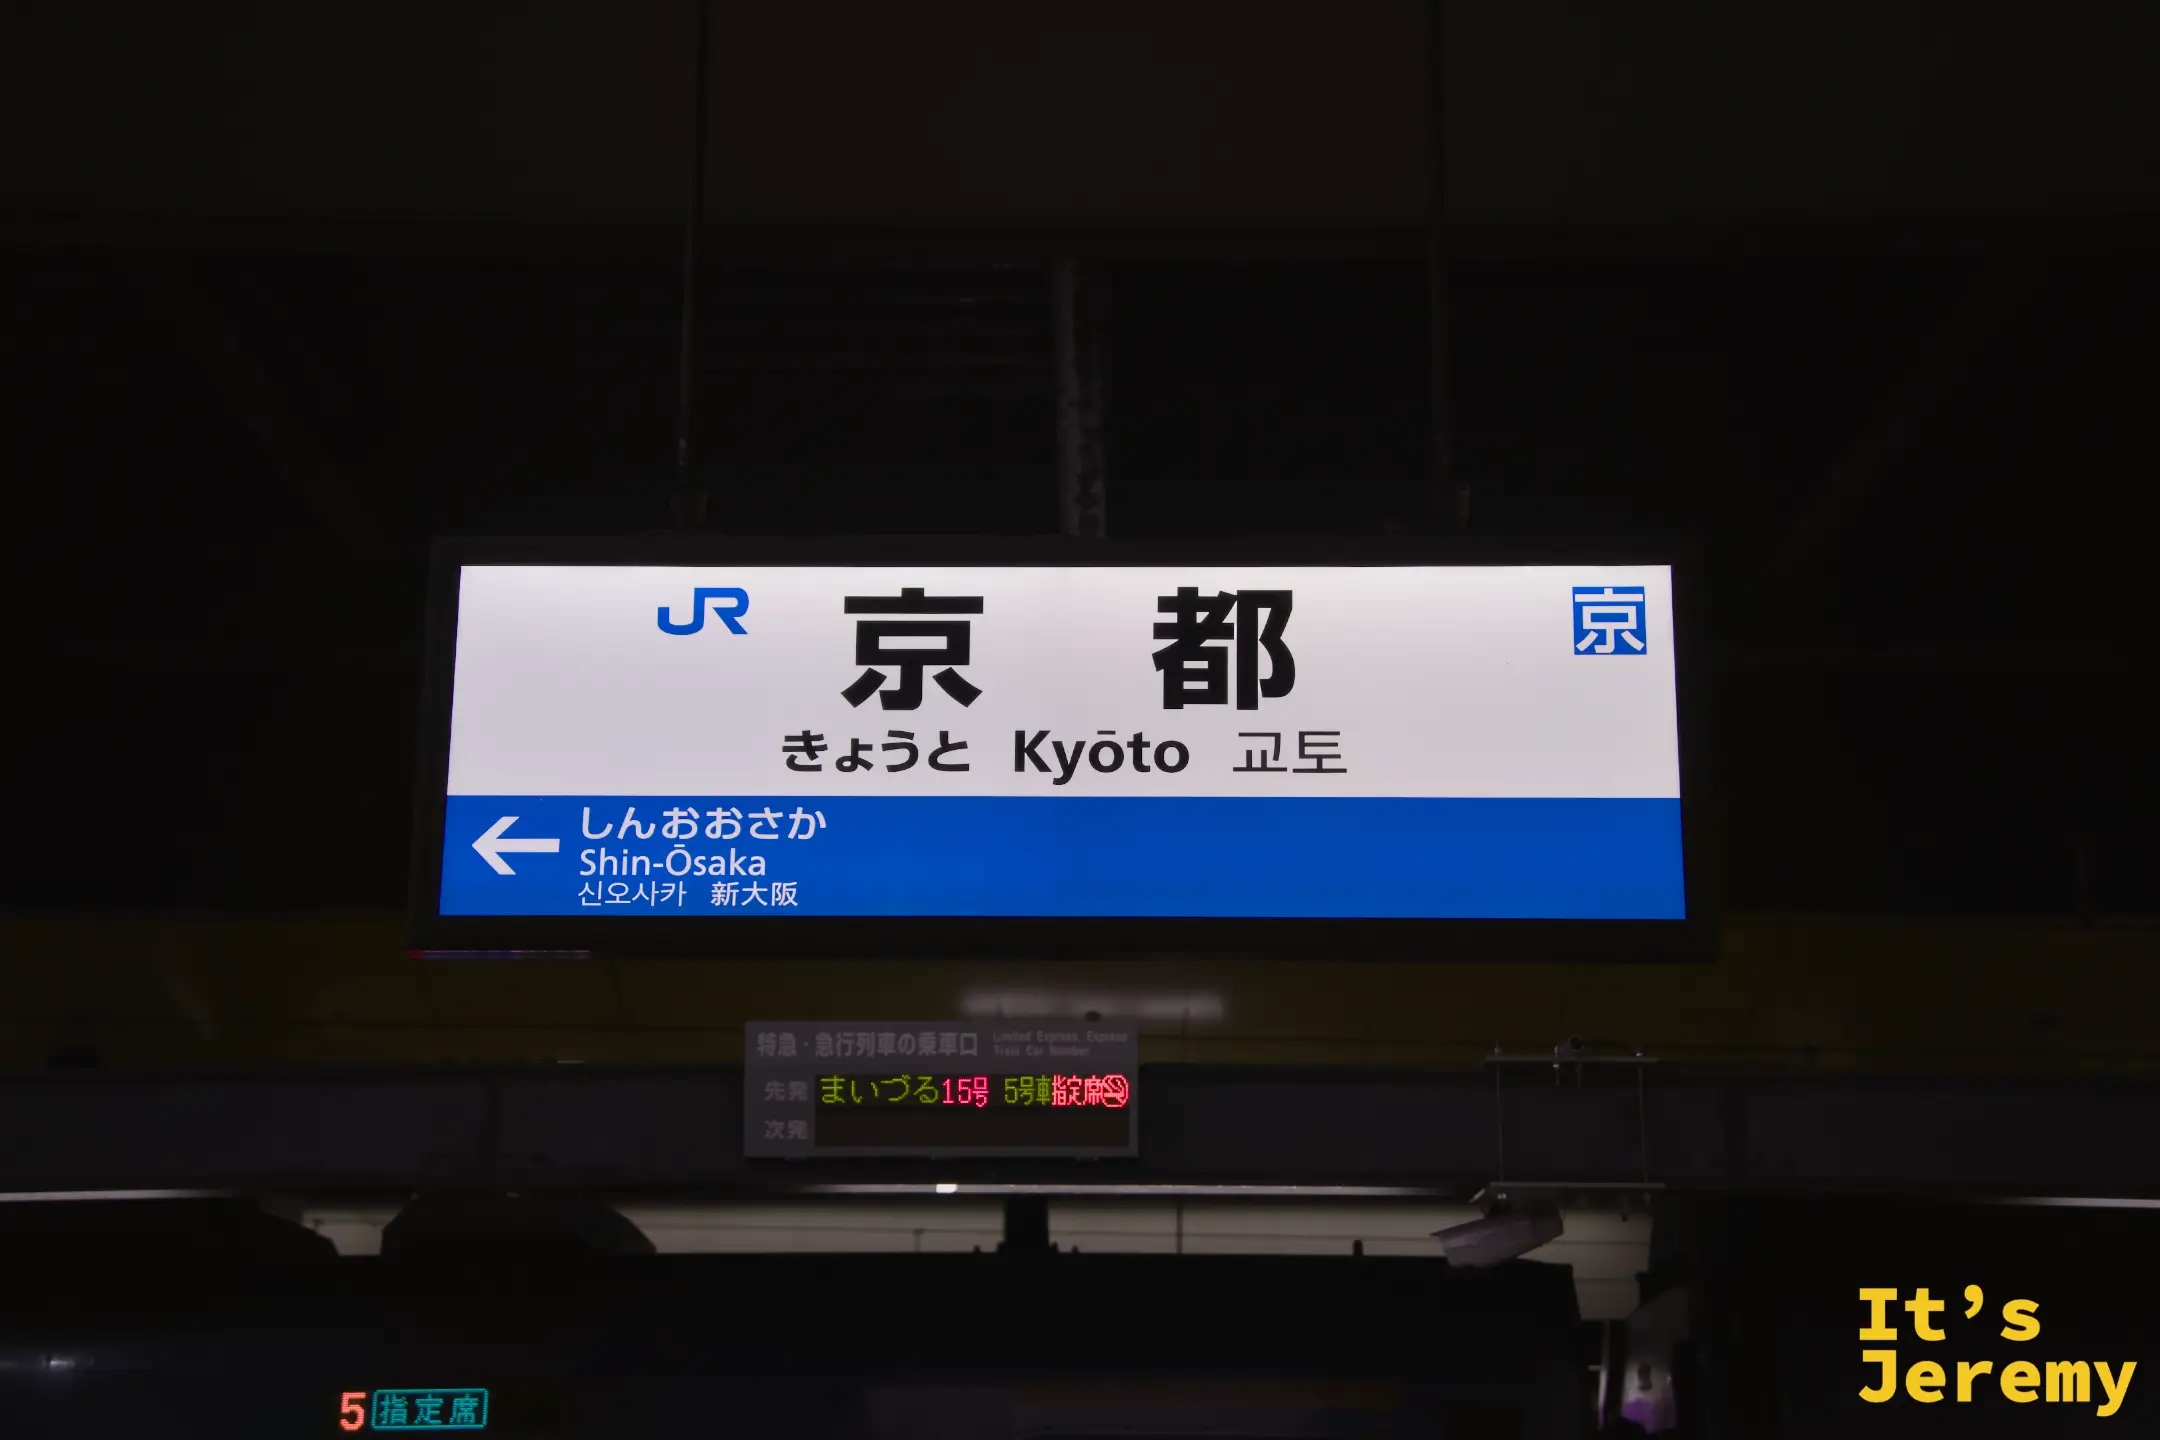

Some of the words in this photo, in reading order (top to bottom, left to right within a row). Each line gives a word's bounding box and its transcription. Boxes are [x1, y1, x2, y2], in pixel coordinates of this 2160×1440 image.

[658, 588, 749, 635] JR
[1574, 587, 1646, 654] 京
[783, 730, 970, 773] きょうと
[1015, 731, 1189, 785] Kyōto
[1233, 731, 1347, 773] 교토
[582, 806, 827, 839] しんおおさか
[580, 844, 766, 876] Shin-Ōsaka
[578, 881, 687, 907] 신오사카
[711, 881, 798, 907] 新大阪
[764, 1081, 808, 1101] 先発
[763, 1120, 808, 1140] 次発
[340, 1391, 366, 1431] 5
[379, 1393, 480, 1426] 指定席
